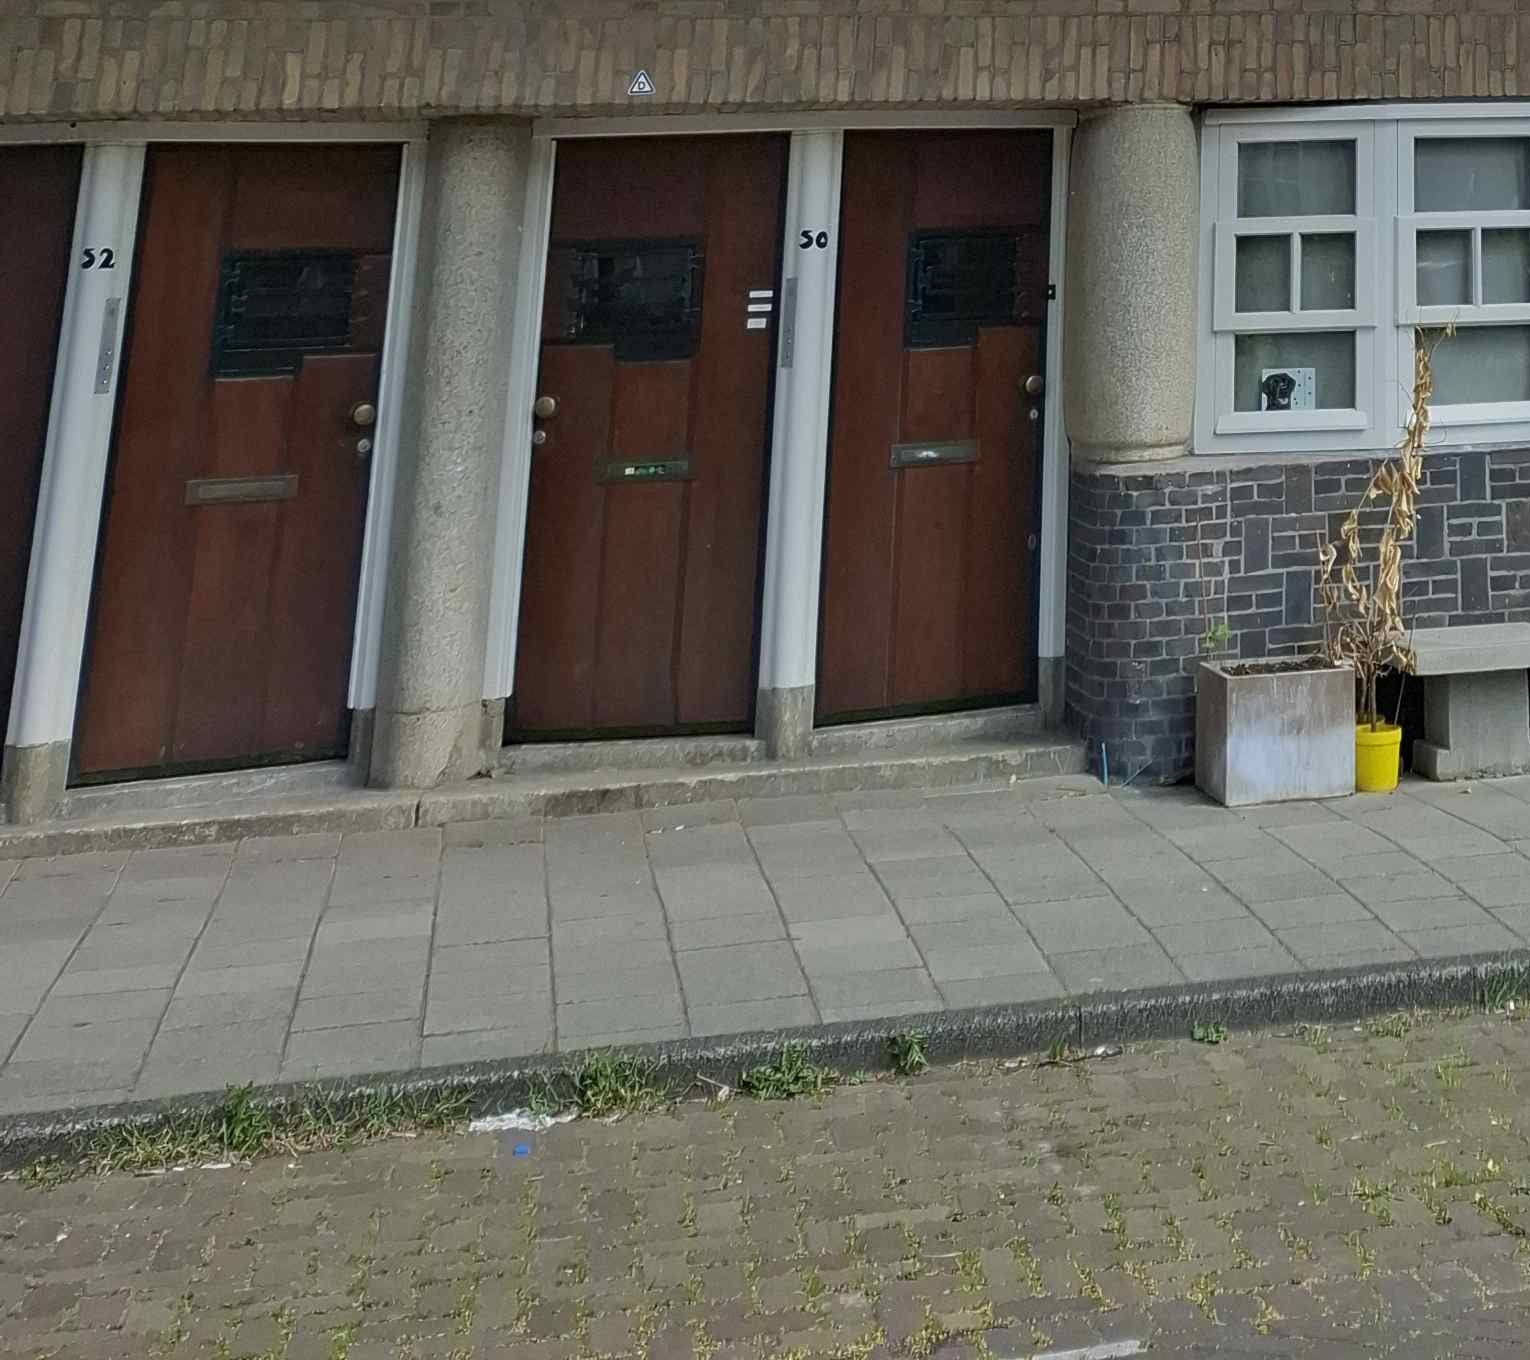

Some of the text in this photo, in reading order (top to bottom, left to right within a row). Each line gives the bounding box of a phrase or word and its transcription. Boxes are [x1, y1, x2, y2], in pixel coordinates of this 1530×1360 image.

[638, 81, 646, 90] D
[800, 230, 828, 249] 50
[81, 248, 115, 269] 52
